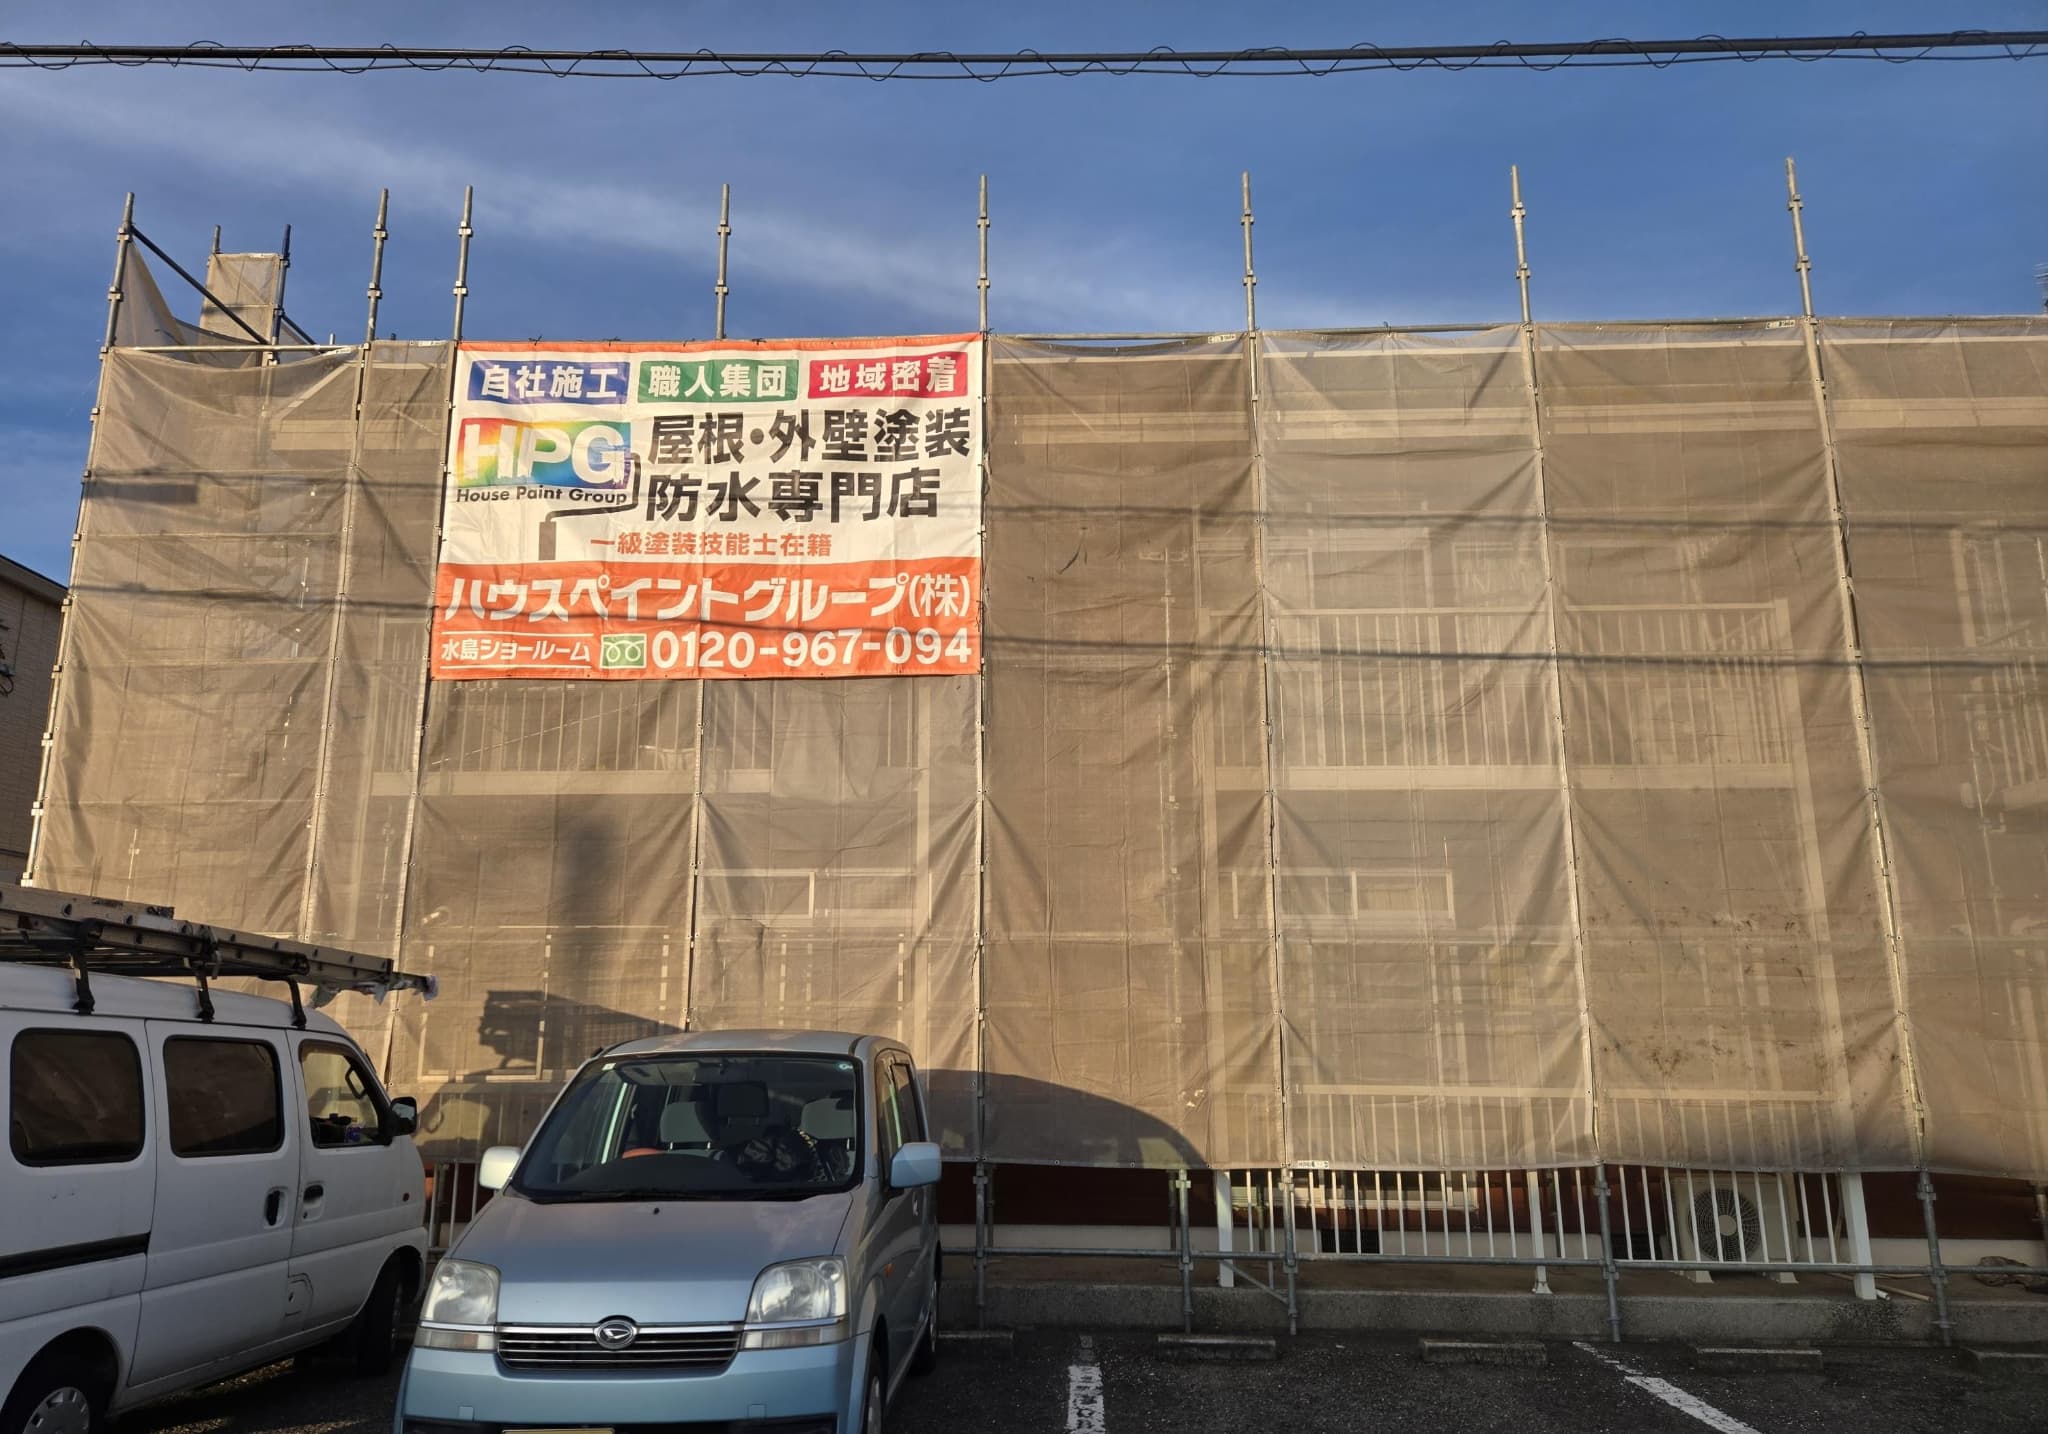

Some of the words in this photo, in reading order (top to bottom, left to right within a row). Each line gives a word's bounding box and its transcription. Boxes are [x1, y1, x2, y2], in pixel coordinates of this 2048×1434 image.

[481, 364, 618, 399] 自社施工
[648, 363, 788, 398] 職人集団
[820, 356, 957, 393] 地域密着
[464, 424, 625, 484] HPG
[648, 407, 971, 465] 屋根・外壁塗装
[456, 488, 510, 502] House
[516, 485, 562, 500] Paint
[569, 488, 627, 505] Group
[646, 467, 941, 523] 防水専門店
[590, 532, 832, 557] 一級塗装技能士在籍
[444, 572, 971, 623] ハウスペイントグループ(株)
[441, 638, 590, 662] 水島ショールーム
[651, 626, 972, 669] 0120-967-094
